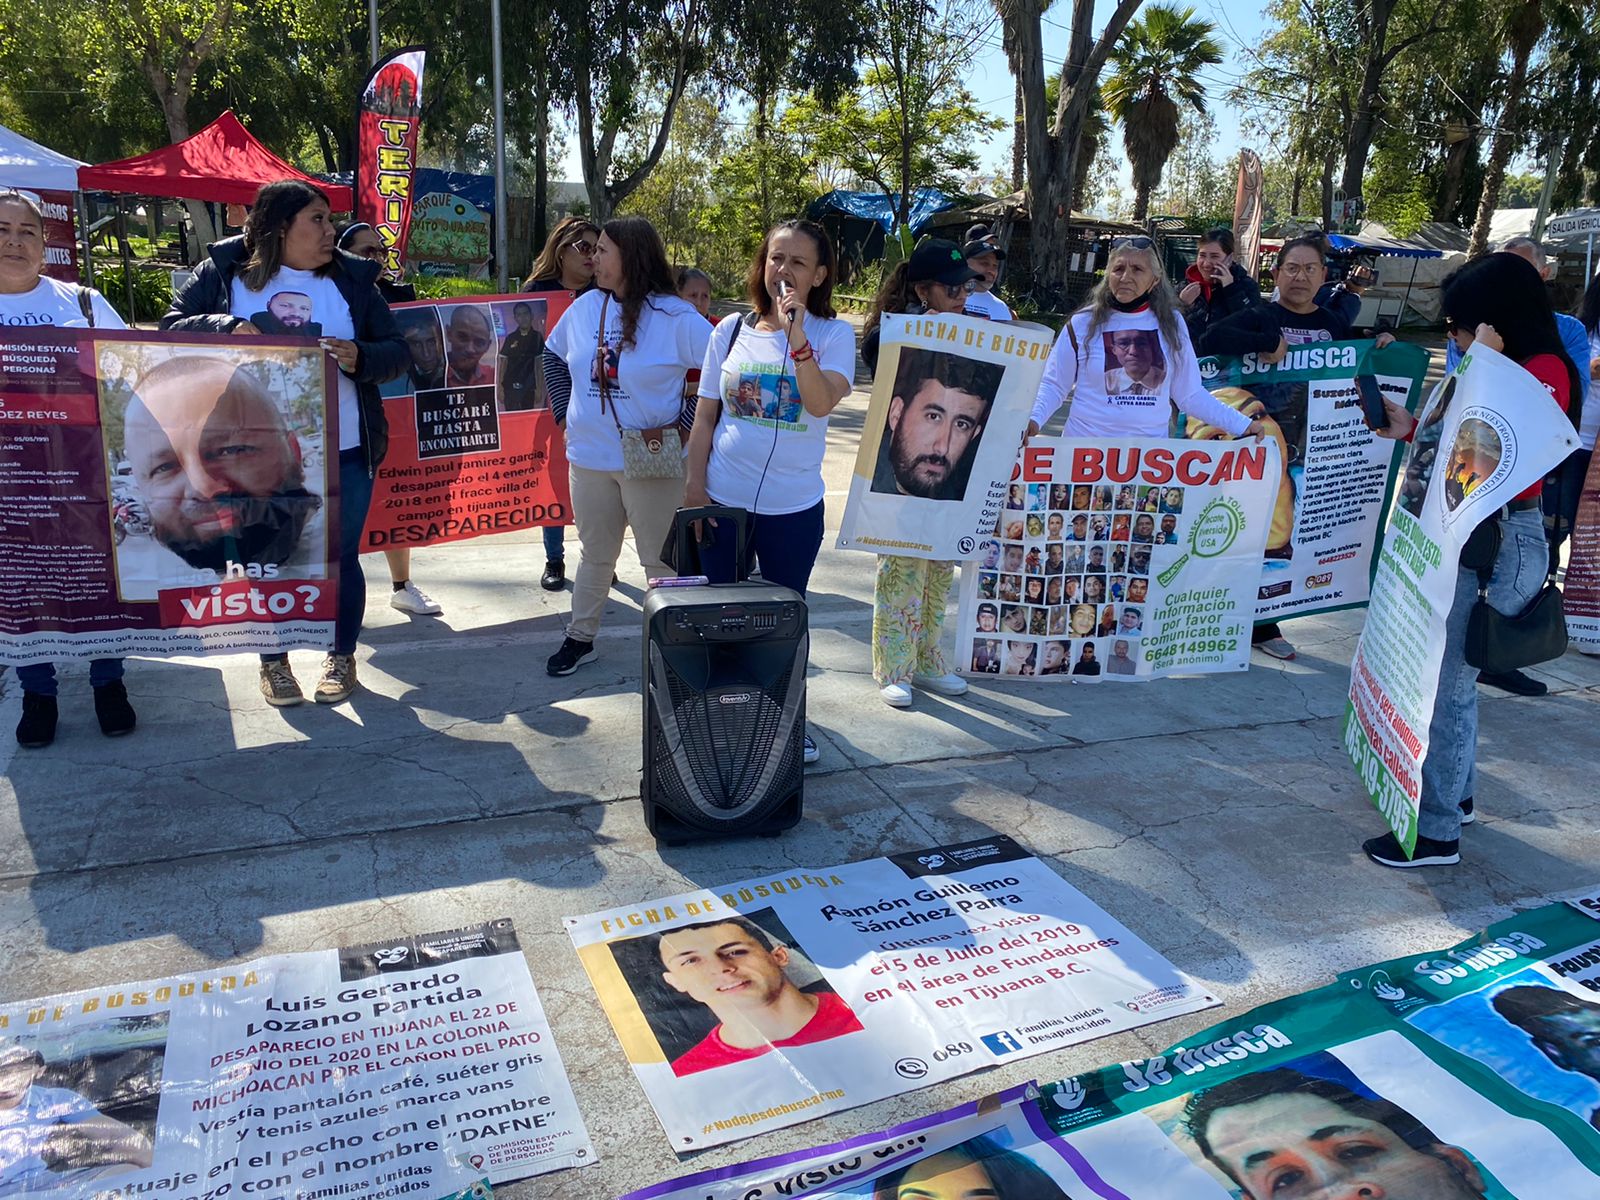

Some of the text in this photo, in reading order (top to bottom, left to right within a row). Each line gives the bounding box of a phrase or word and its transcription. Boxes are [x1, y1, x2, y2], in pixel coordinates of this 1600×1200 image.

[413, 194, 452, 215] PARQUE
[1552, 221, 1575, 234] SALIDA
[37, 345, 80, 353] ESTATAL
[905, 320, 1050, 361] FICHA DE BÚSQU
[2, 353, 57, 363] BÚSQUEDA
[3, 365, 56, 373] PERSONAS
[738, 362, 750, 372] SE
[1277, 346, 1356, 372] busca
[446, 393, 465, 405] TE
[27, 410, 68, 420] REYES
[422, 402, 490, 423] BUSCARÉ
[433, 420, 481, 436] HASTA
[1310, 420, 1350, 432] Edad actual
[420, 433, 497, 452] ENCONTRARTE
[1311, 433, 1340, 443] Estatura
[1348, 438, 1373, 447] delgada
[1071, 447, 1267, 486] BUSCAN
[1320, 453, 1345, 462] morena
[1346, 450, 1363, 458] clara
[1470, 411, 1513, 500] NUESTROS DESAPARECIDOS
[380, 465, 421, 479] Edwin
[425, 461, 454, 476] paul
[458, 456, 506, 470] ramirez
[390, 467, 535, 493] desaparecio el 4 enero
[385, 478, 539, 509] 2018 en el fracc villa del
[397, 495, 531, 522] campo en tijuana b c
[1310, 514, 1326, 523] 2019
[369, 502, 565, 547] DESAPARECIDO
[1200, 538, 1216, 547] USA
[1297, 530, 1332, 544] Tijuana BC
[226, 560, 279, 579] has
[1316, 573, 1332, 583] 089
[180, 585, 320, 620] visto?
[1165, 587, 1230, 606] Cualquier
[1281, 595, 1324, 608] desaparecidos
[1333, 590, 1343, 598] BC
[1153, 598, 1235, 620] información
[1161, 613, 1223, 635] por favor
[1226, 623, 1245, 636] al:
[1572, 623, 1598, 631] TIENES
[21, 638, 55, 647] ALGUNA
[1145, 639, 1237, 662] 6648149962
[1177, 654, 1224, 665] anónimo)
[600, 873, 845, 933] FICHA DE BÚSQUEDA
[820, 877, 1020, 921] Ramón Guillemo
[851, 894, 1023, 932] Sánchez Parra
[955, 914, 1041, 936] vez visto
[892, 923, 1081, 972] 5 de Julio del 2019
[1447, 931, 1547, 972] busca
[864, 937, 1120, 1002] en área de Fundadores
[1547, 943, 1600, 978] Faust
[266, 973, 460, 1012] Luis Gerardo
[935, 962, 1091, 1009] en Tijuana B.C.
[247, 987, 482, 1037] Lozano Partida
[1016, 1007, 1104, 1035] Familias Unidas
[211, 1001, 518, 1068] DESAPARECIO EN TIJUANA EL 22 DE
[1028, 1017, 1111, 1044] Desaparecidos
[289, 1020, 510, 1068] DEL 2020 EN LA COLONIA
[1119, 1024, 1293, 1092] Se busca
[192, 1032, 541, 1112] MICHOACAN EL CAÑON DEL PATO
[198, 1053, 543, 1134] Vestía pantalón suéter gris
[256, 1078, 514, 1139] tenis azules marca vans
[702, 1088, 845, 1134] #Nodejesdebuscarme
[207, 1095, 551, 1179] en el pecho con el nombre
[241, 1173, 292, 1193] con
[335, 1141, 439, 1173] nombre
